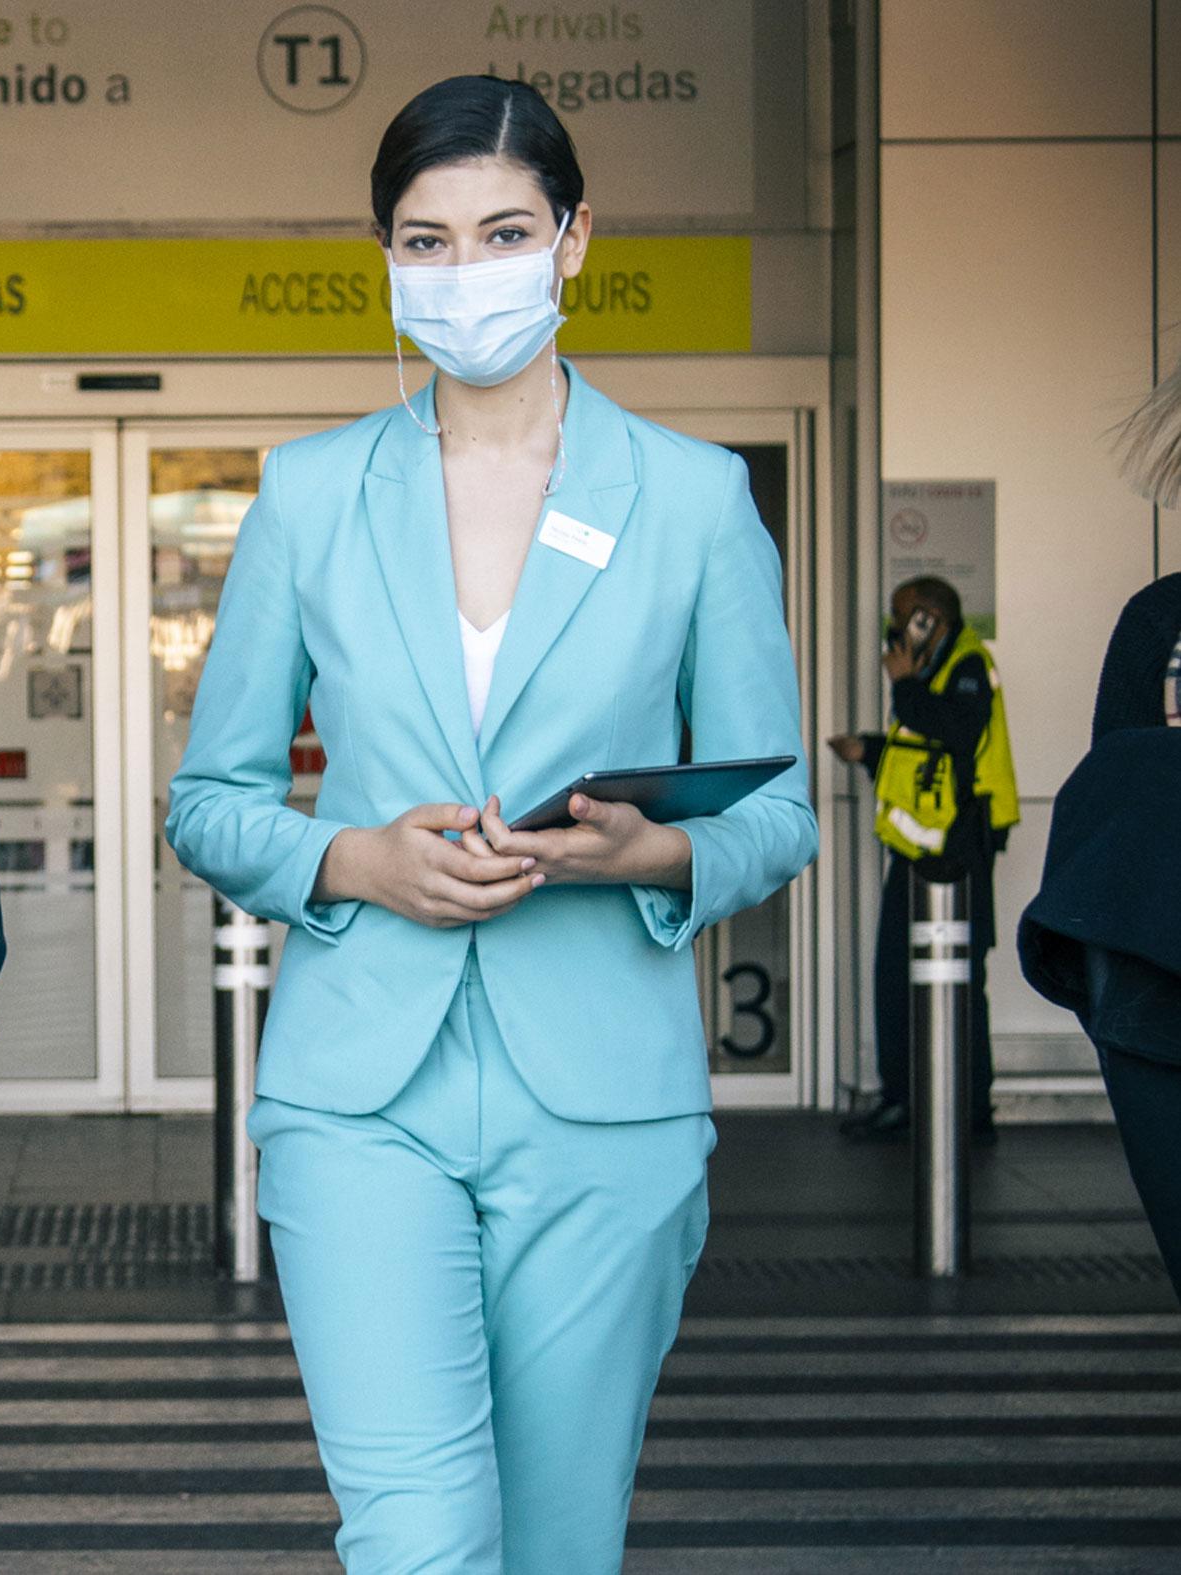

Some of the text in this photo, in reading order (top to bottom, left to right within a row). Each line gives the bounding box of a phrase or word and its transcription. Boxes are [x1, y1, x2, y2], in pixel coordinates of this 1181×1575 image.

[30, 12, 68, 46] to
[484, 5, 643, 40] Arrivals
[274, 35, 350, 85] T1
[106, 74, 131, 105] a
[240, 272, 369, 315] ACCESS
[562, 271, 652, 315] OURS
[721, 962, 775, 1058] 3
